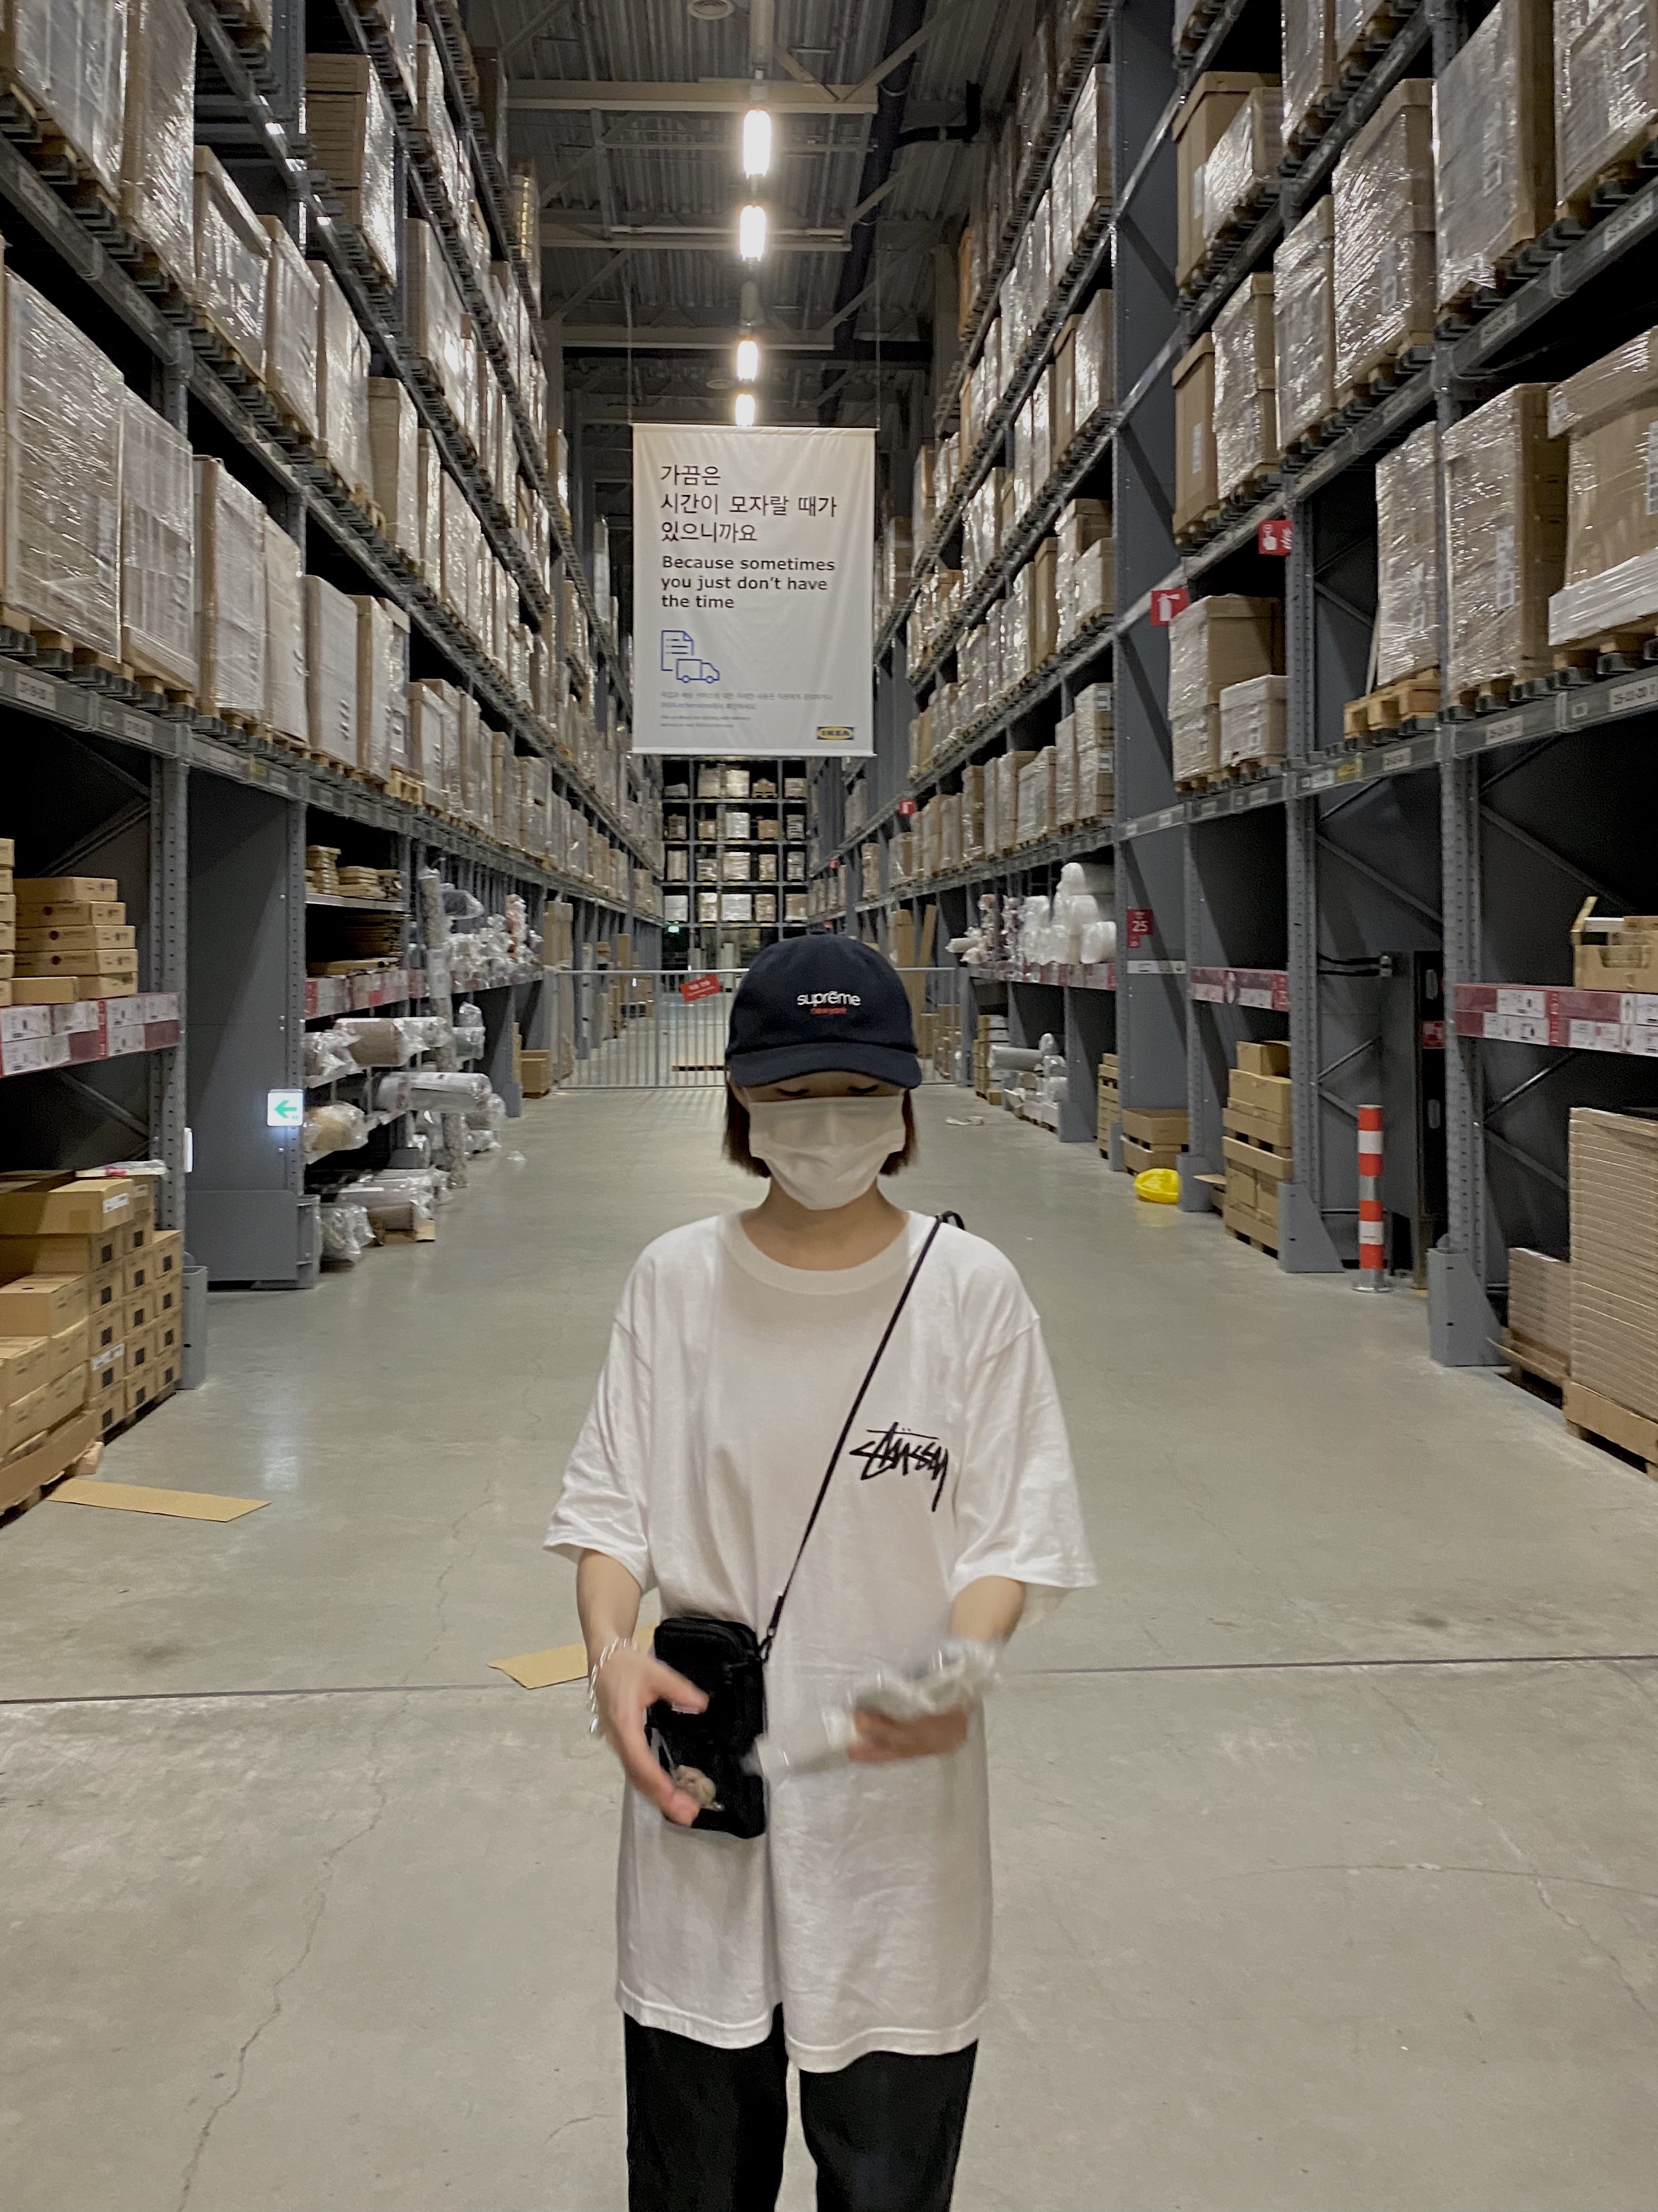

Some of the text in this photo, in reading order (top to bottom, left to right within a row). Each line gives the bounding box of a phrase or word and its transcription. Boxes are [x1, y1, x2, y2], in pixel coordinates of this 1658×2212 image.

[661, 464, 722, 486] 가끔은
[661, 493, 837, 517] 시간이 모자랄 때가
[661, 521, 758, 543] 있으니까요
[662, 555, 835, 571] Because sometimes
[661, 576, 828, 591] you just don't have
[661, 595, 735, 608] the time
[1132, 920, 1148, 932] 25
